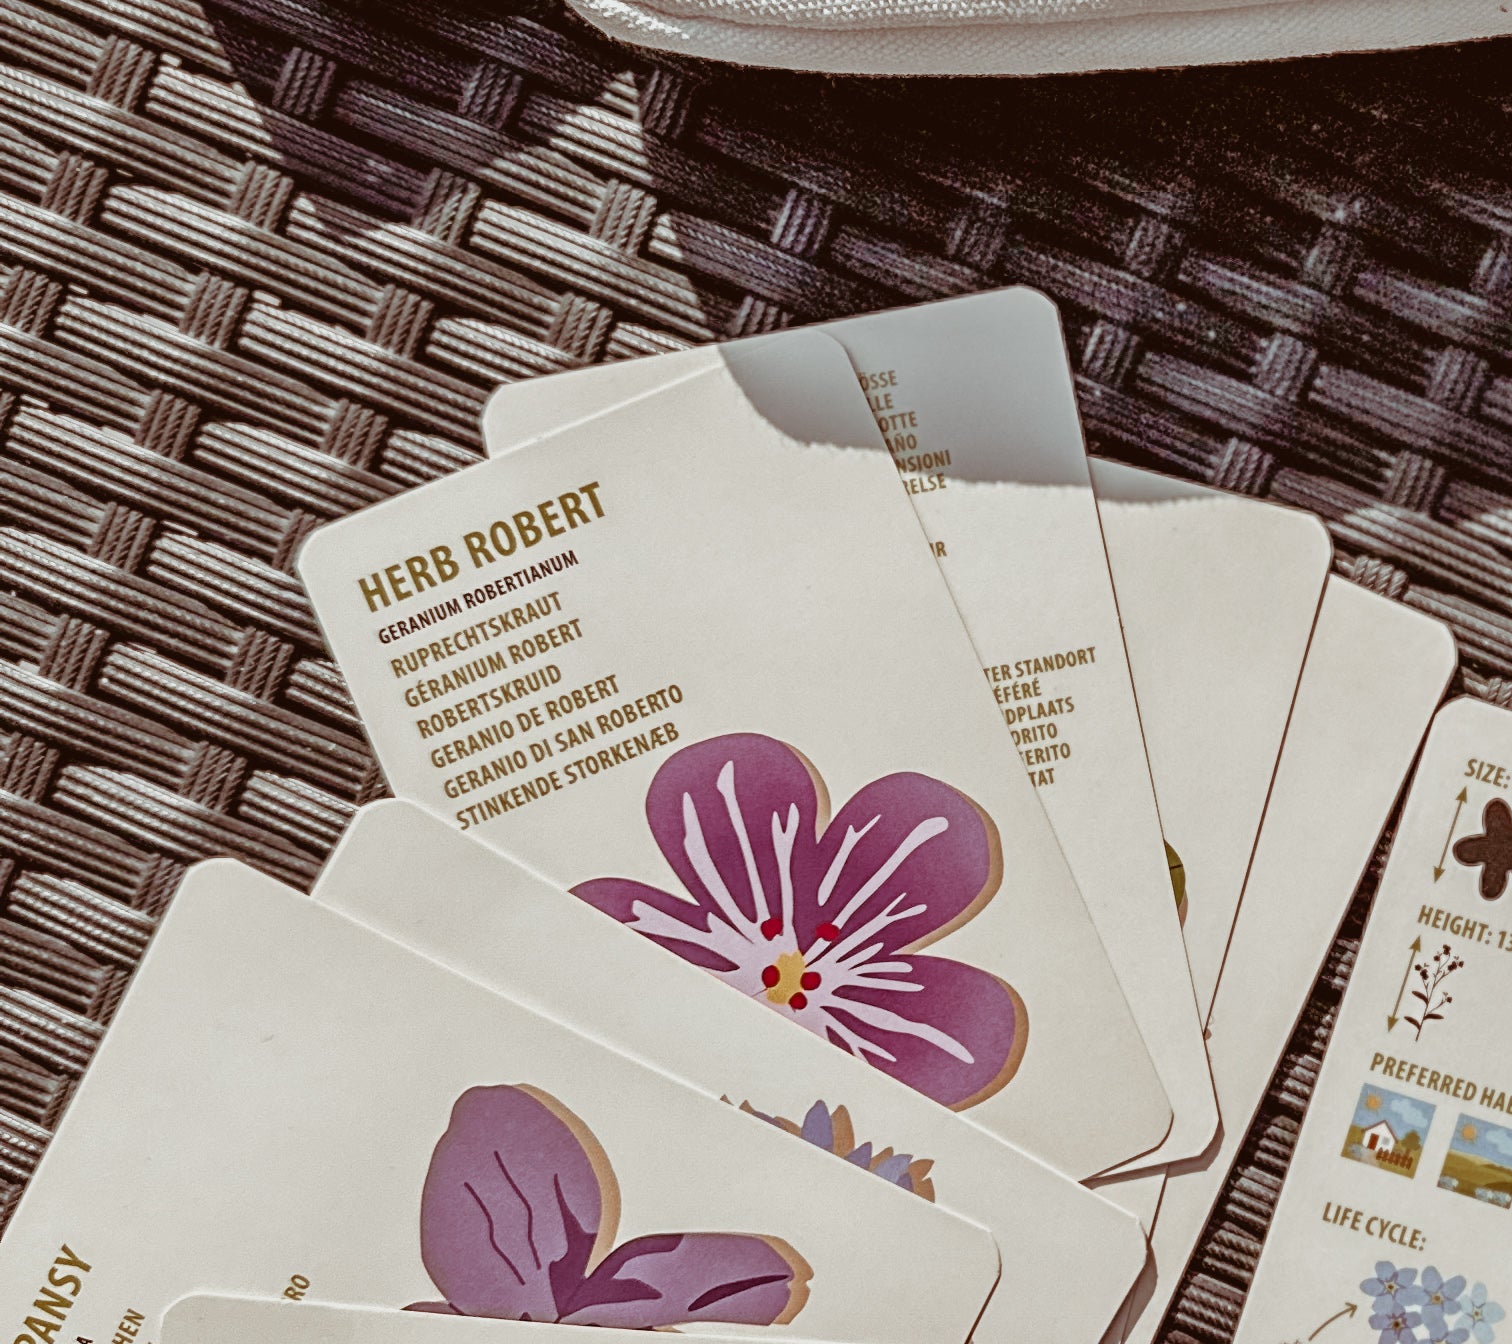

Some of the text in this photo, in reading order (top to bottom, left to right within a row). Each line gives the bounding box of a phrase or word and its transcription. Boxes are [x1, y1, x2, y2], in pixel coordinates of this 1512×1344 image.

[857, 370, 898, 391] ÖSSE
[878, 411, 918, 433] OTTE
[895, 450, 951, 473] NSIONI
[358, 481, 605, 613] HERB ROBERT
[378, 550, 579, 644] GERANIUM ROBERTIANUM
[391, 592, 561, 678] RUPRECHTSKRAUT
[405, 618, 582, 707] GÉRANIUM ROBERT
[1014, 647, 1095, 677] STANDORT
[416, 665, 561, 739] ROBERTSKRUID
[992, 677, 1042, 704] ÉFÉRÉ
[1005, 696, 1074, 725] DPLAATS
[431, 674, 619, 768] GERANIO DE ROBERT
[444, 685, 683, 798] GERANIO DI SAN ROBERTO
[1010, 723, 1057, 746] ORITO
[1022, 743, 1070, 765] ERITO
[1464, 759, 1510, 788] SIZE:
[456, 722, 679, 830] STINKENDE STORKENÆB
[1418, 905, 1492, 944] HEIGHT:
[1370, 1053, 1477, 1101] PREFERRED
[1323, 1202, 1426, 1251] LIFE CYCLE:
